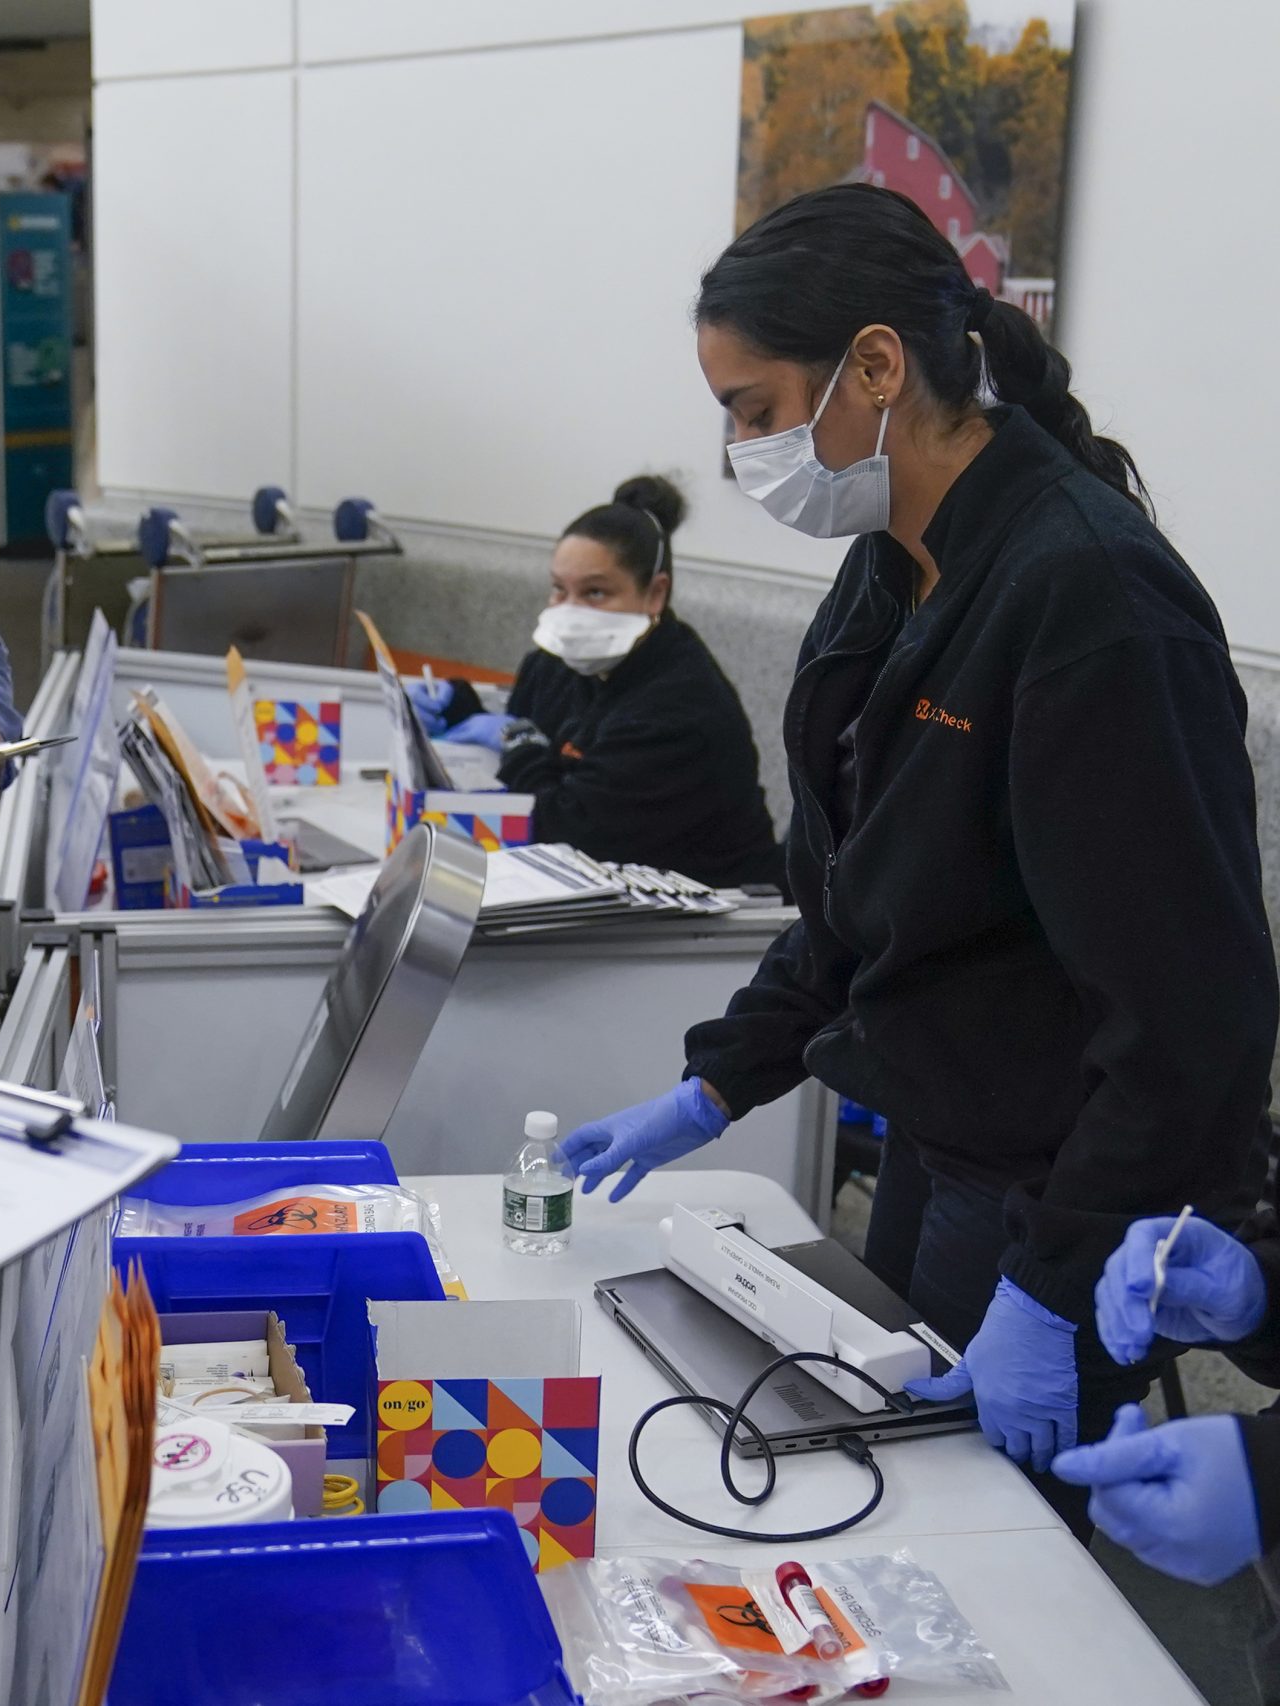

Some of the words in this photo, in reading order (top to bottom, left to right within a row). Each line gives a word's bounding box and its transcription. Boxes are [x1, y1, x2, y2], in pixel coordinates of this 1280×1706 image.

[383, 1400, 426, 1412] on/go
[834, 1585, 855, 1602] BAG
[847, 1600, 882, 1638] SPECIMEN
